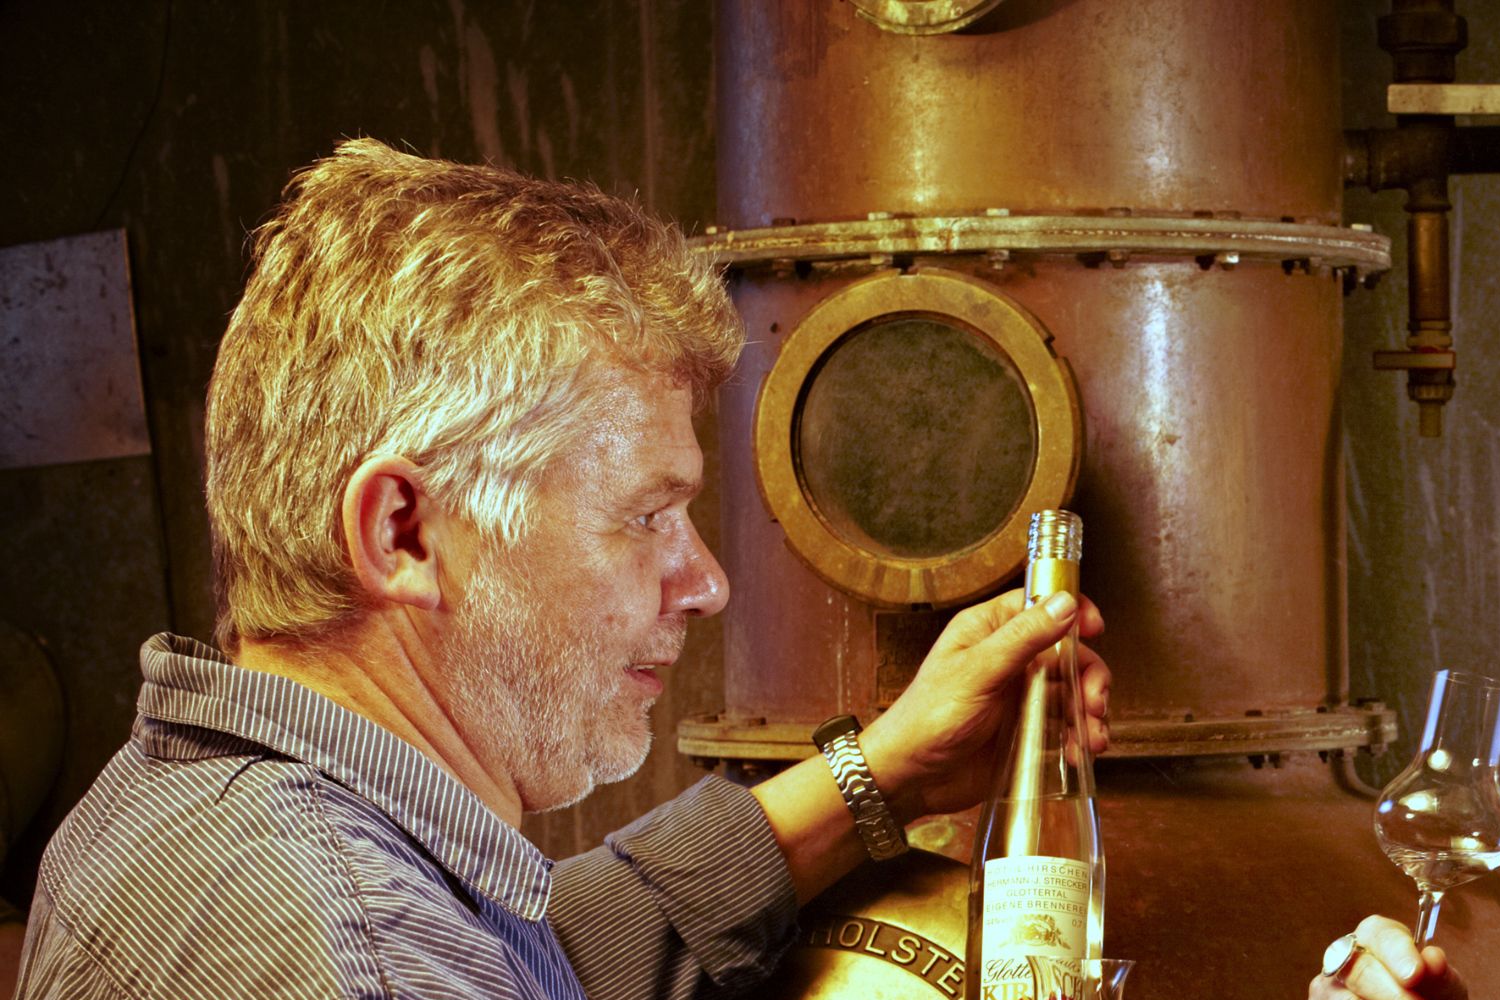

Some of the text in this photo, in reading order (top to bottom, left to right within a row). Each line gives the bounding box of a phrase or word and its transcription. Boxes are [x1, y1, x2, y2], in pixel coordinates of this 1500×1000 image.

[1027, 863, 1088, 879] HIRSCHEN
[1043, 876, 1088, 890] STRECKER
[1006, 887, 1068, 899] GLOTTERTAL
[986, 900, 1023, 912] EIGENE
